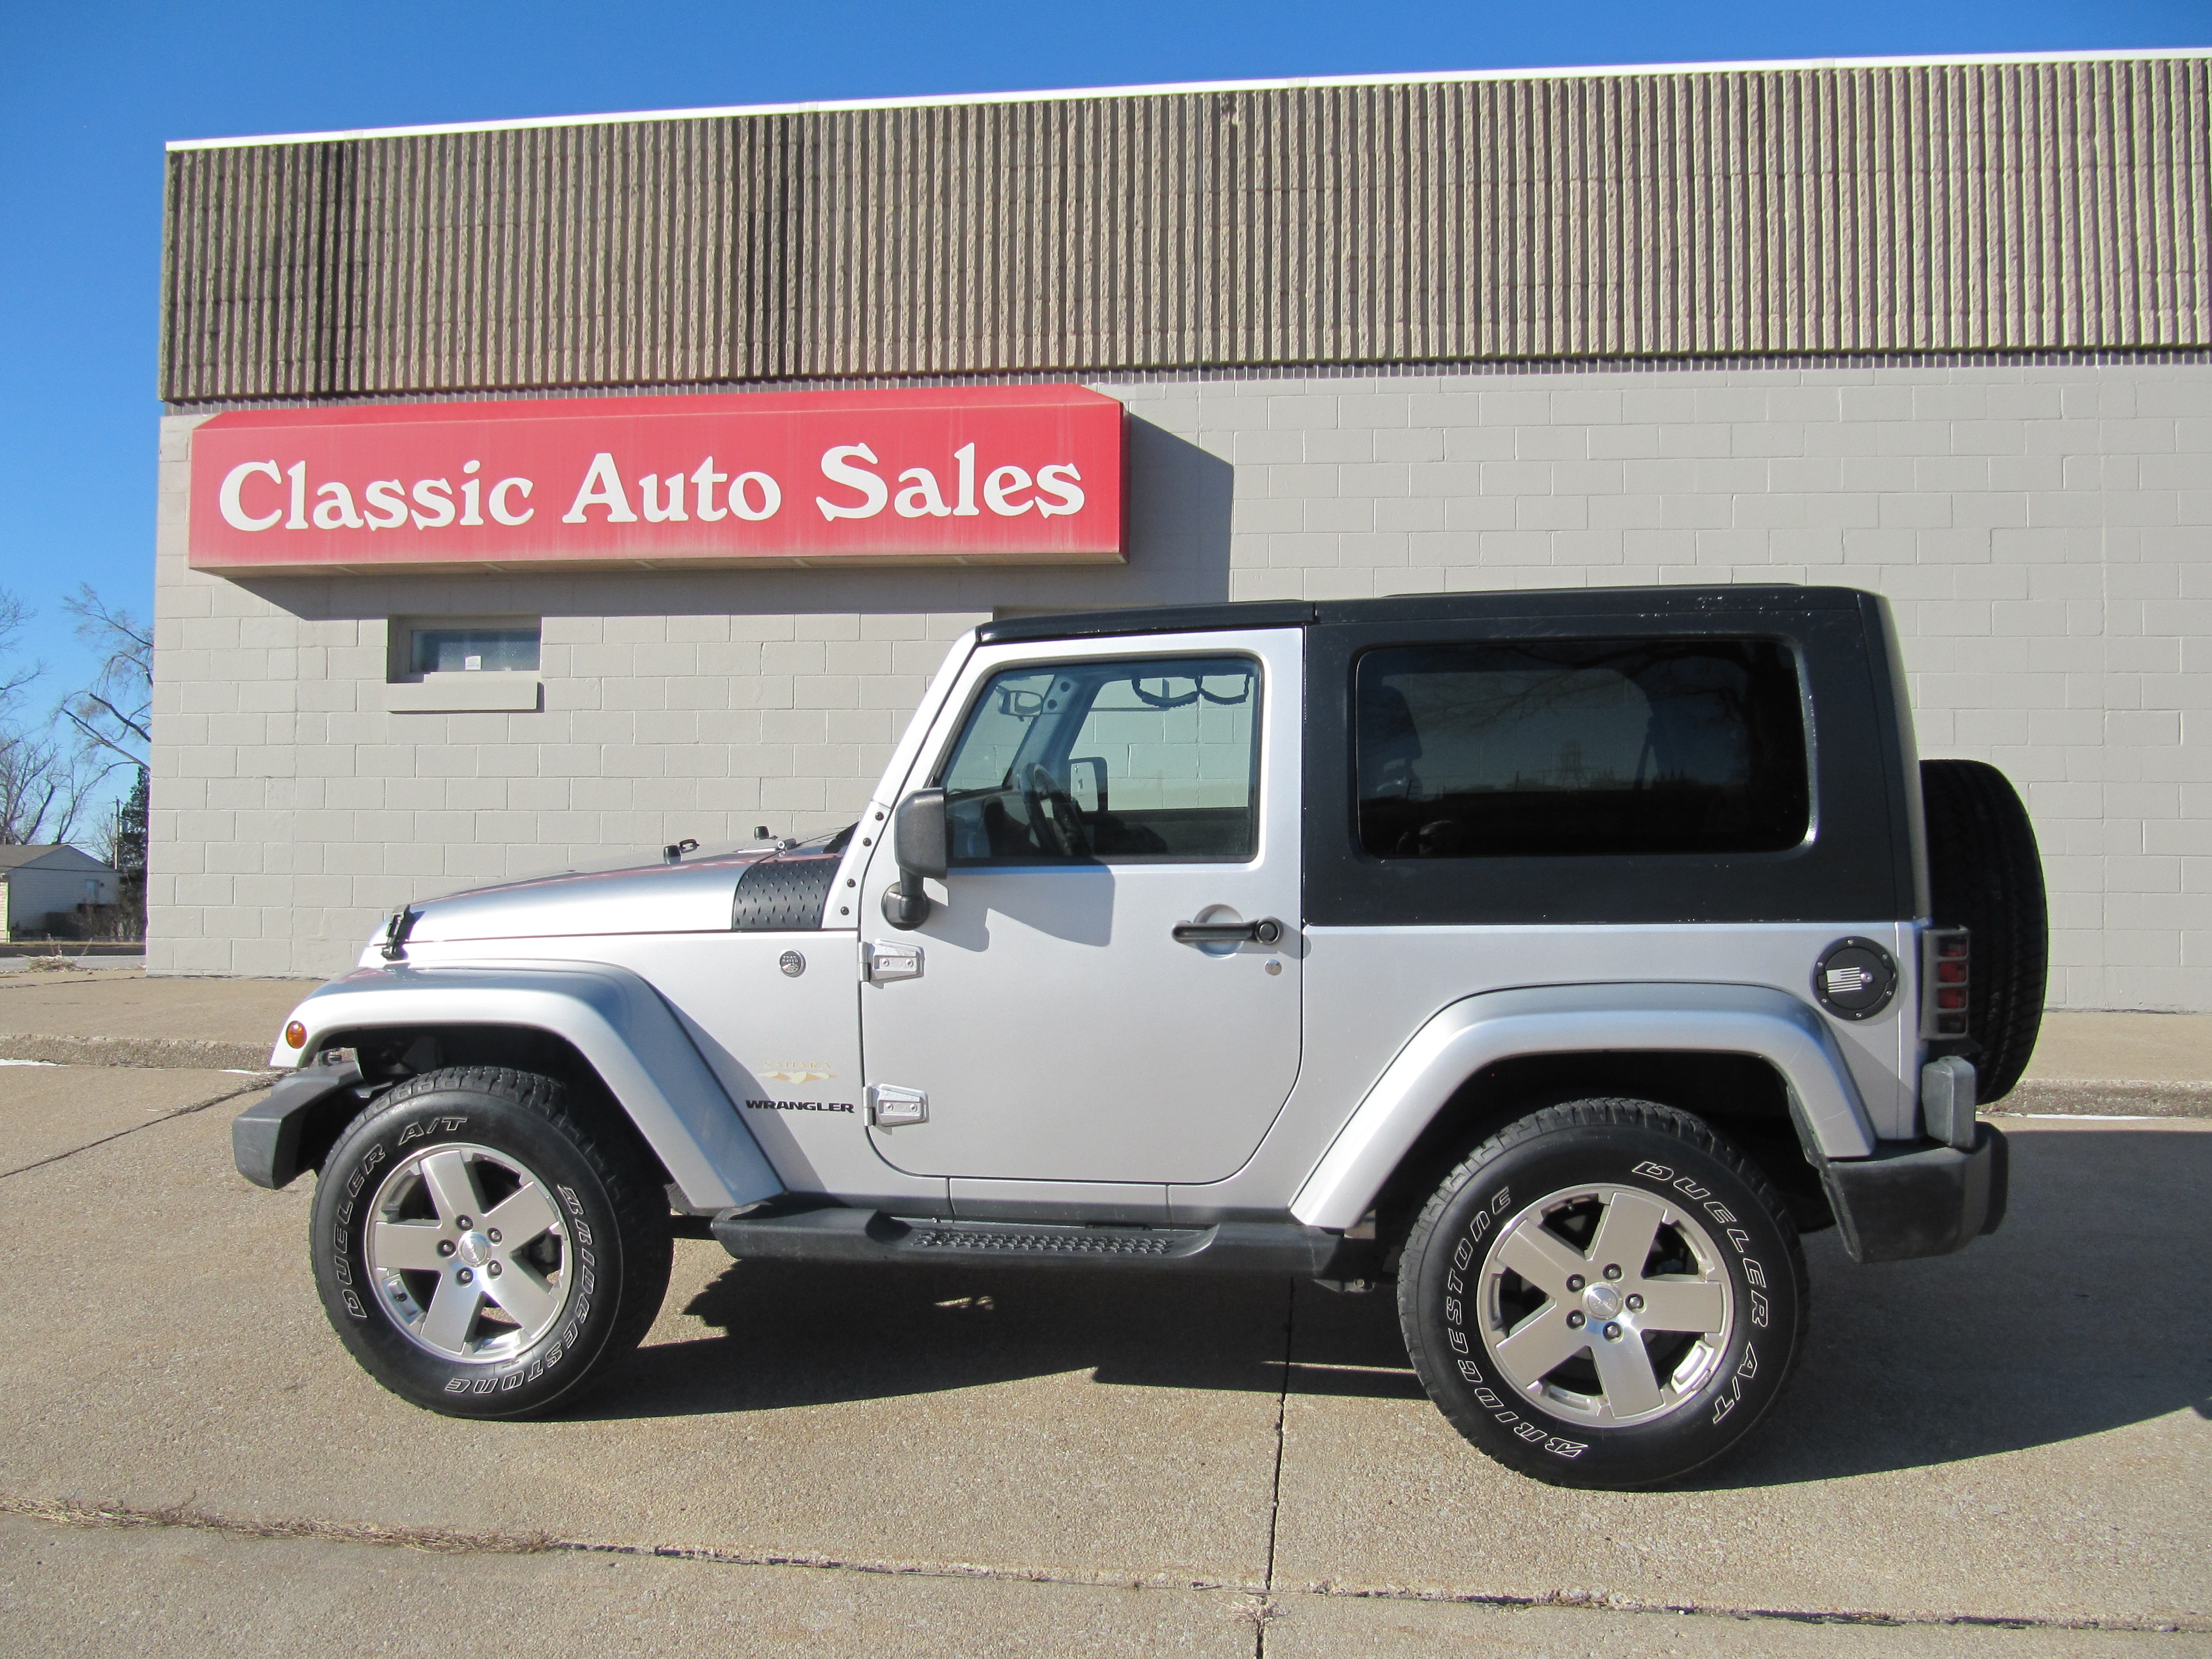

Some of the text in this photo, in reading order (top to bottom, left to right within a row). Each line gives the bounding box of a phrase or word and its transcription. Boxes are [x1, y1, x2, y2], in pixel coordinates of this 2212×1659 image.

[219, 442, 1086, 531] Classic Auto Sales
[745, 1099, 855, 1114] WRANGLER
[764, 1060, 832, 1070] SAHARA
[334, 1117, 467, 1318] DUELER A/T
[445, 1184, 596, 1394] BRIDGESTONE
[1631, 1161, 1768, 1425] DUELER A/T
[1446, 1186, 1589, 1458] BRIDGESTONE
